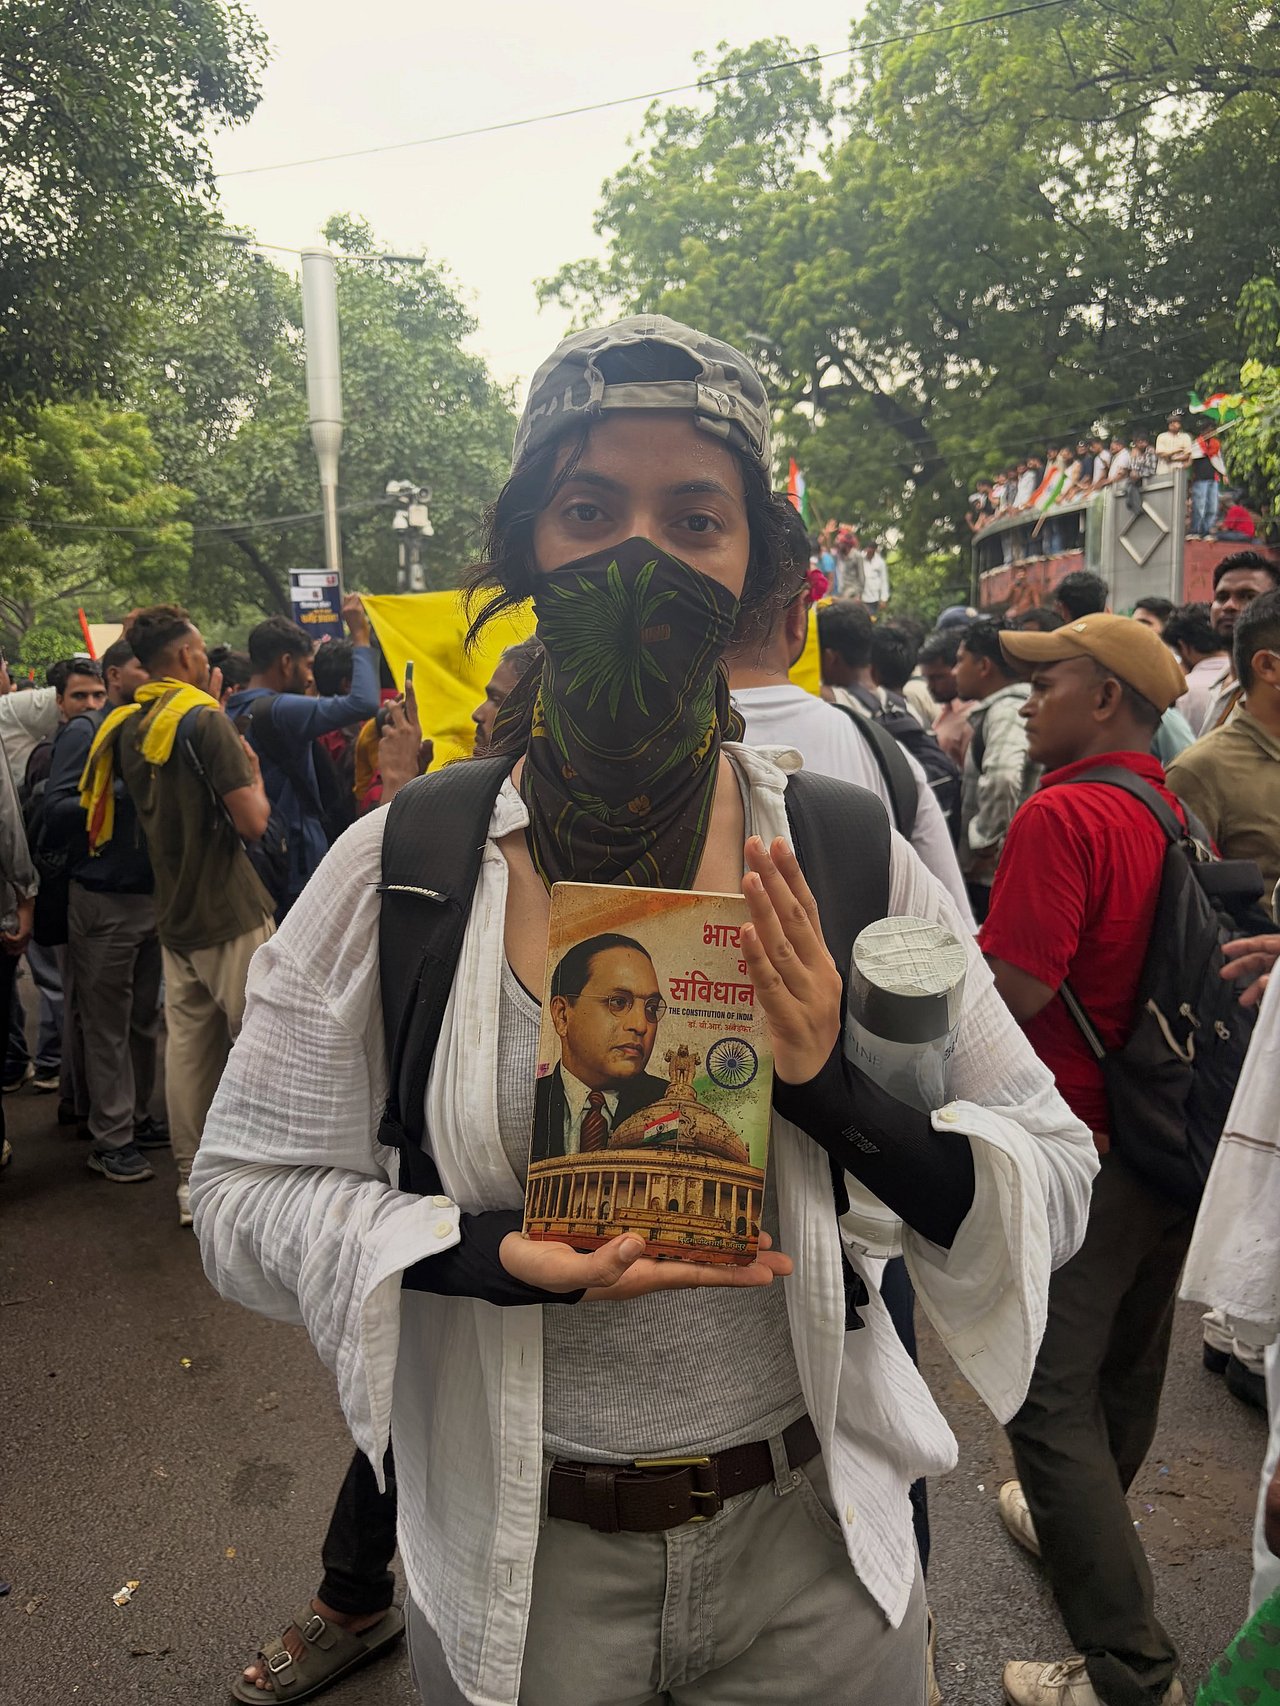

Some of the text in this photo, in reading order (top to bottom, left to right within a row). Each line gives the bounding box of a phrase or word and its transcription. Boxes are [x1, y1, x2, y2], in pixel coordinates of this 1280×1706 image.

[669, 970, 755, 1007] संविधान
[669, 1007, 754, 1021] THE CONSTITUTION OF INDIA
